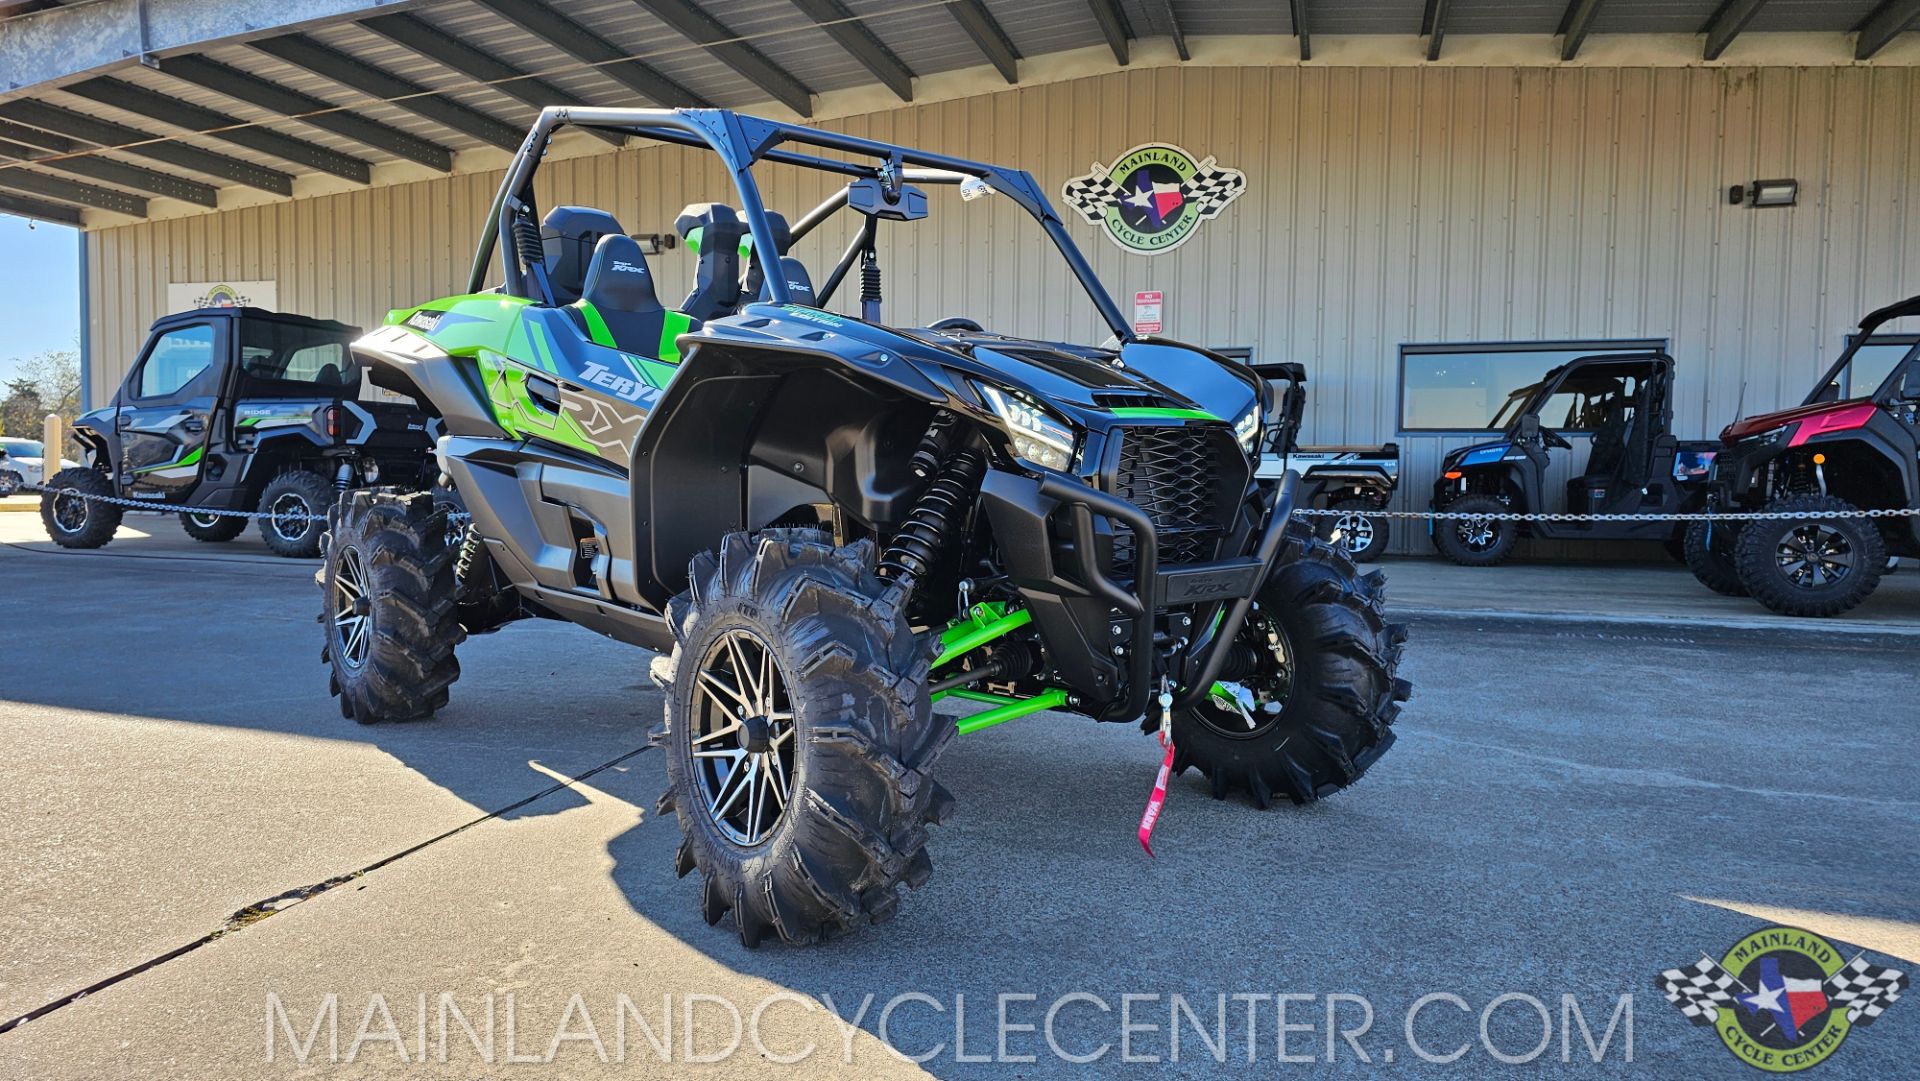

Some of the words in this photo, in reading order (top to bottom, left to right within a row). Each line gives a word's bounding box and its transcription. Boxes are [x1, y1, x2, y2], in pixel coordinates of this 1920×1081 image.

[1119, 151, 1187, 174] MAINLAND
[1112, 219, 1145, 245] CYCLE
[1149, 214, 1193, 246] CENTER
